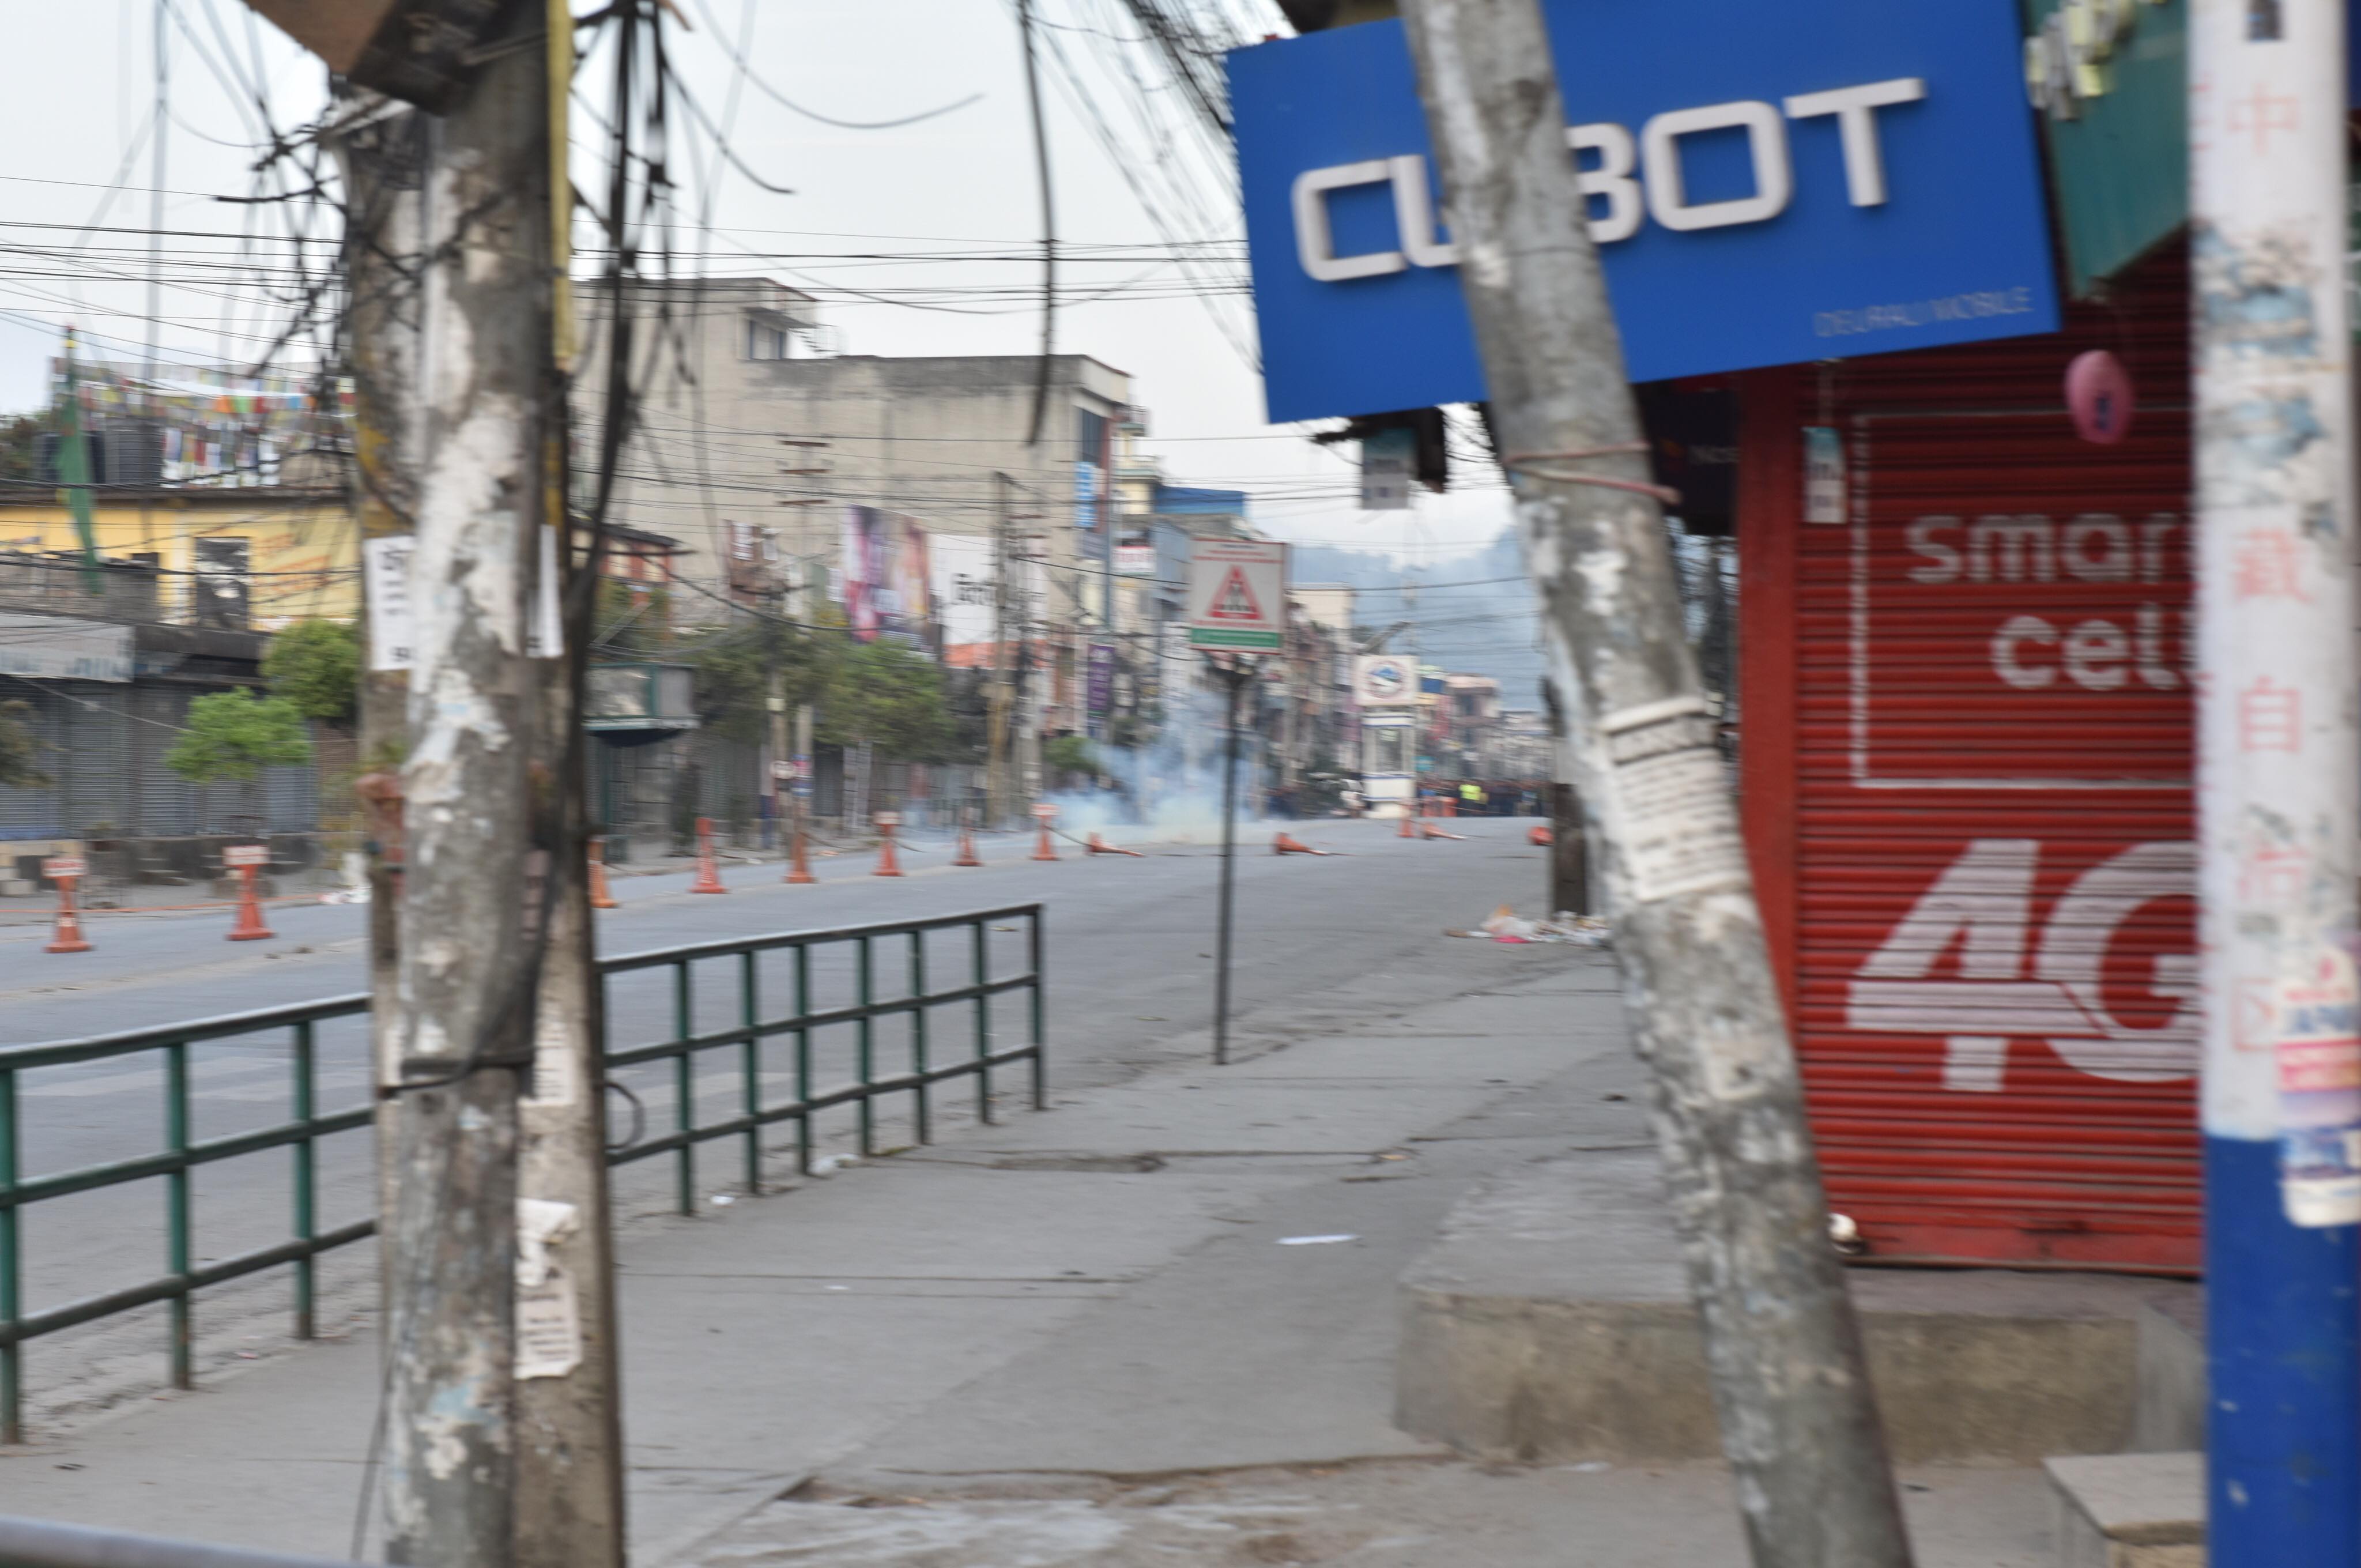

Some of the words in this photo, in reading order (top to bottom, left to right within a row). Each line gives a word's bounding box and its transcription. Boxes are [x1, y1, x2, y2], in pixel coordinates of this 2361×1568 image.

[1291, 77, 1928, 281] CUBOT
[1904, 511, 2195, 586] smar
[1990, 601, 2195, 692] cel
[1846, 839, 2200, 1093] 4G
